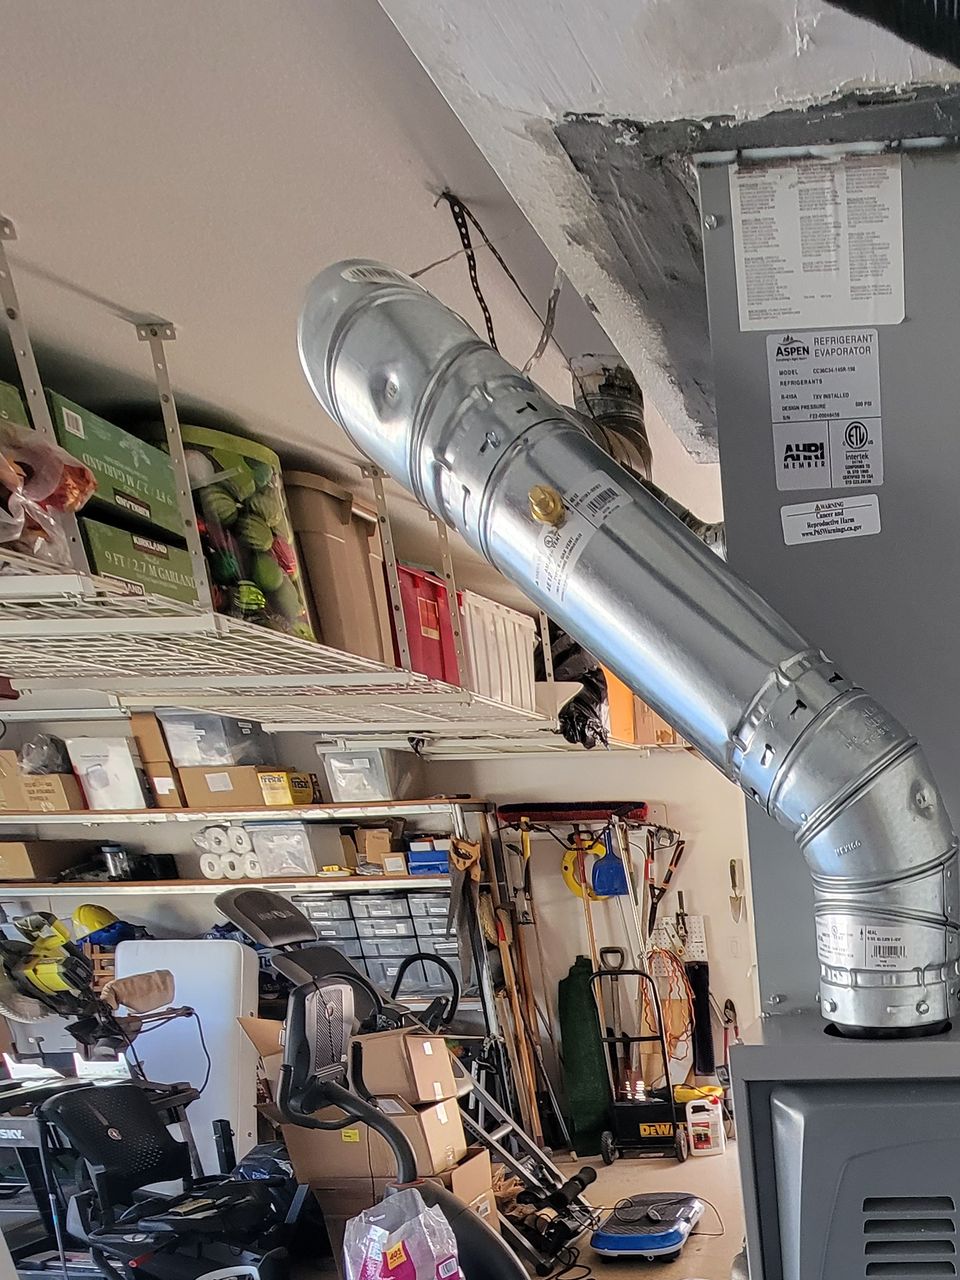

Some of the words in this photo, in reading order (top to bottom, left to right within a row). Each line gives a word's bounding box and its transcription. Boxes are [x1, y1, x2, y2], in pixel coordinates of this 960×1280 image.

[814, 335, 873, 345] REFRIGERANT
[776, 346, 810, 356] ASPEN
[815, 346, 871, 357] EVAPORATOR
[784, 461, 825, 469] MEMBER
[807, 519, 839, 528] Reproductive
[133, 535, 168, 554] KIRKLAND
[105, 550, 112, 562] 9
[113, 553, 125, 567] FT
[148, 564, 158, 577] M
